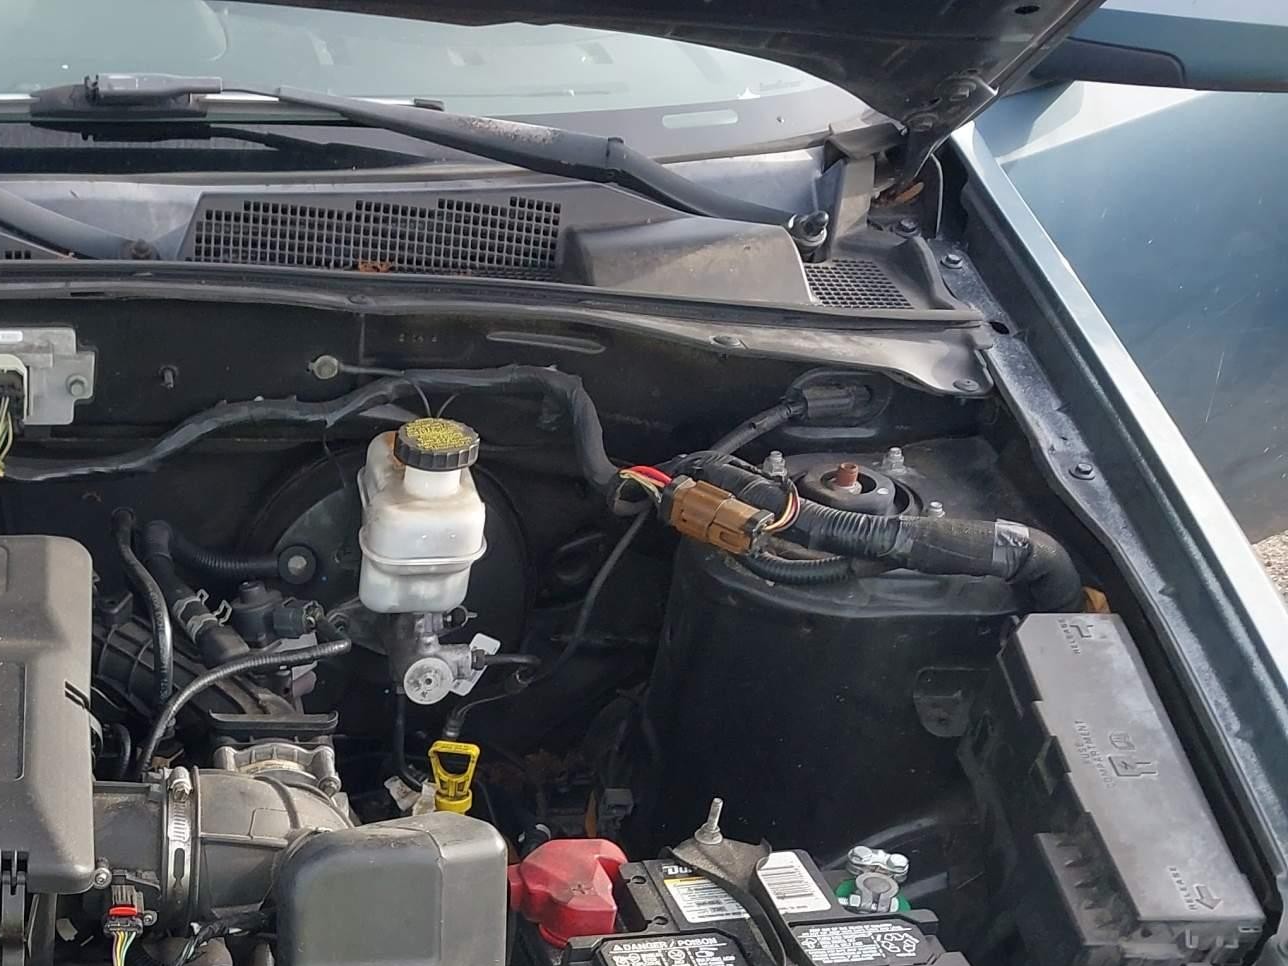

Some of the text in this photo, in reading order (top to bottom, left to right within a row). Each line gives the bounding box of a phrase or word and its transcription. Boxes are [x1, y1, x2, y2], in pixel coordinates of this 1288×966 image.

[1168, 866, 1198, 911] RELEASE
[622, 941, 668, 951] DANGER
[677, 937, 718, 947] POISON
